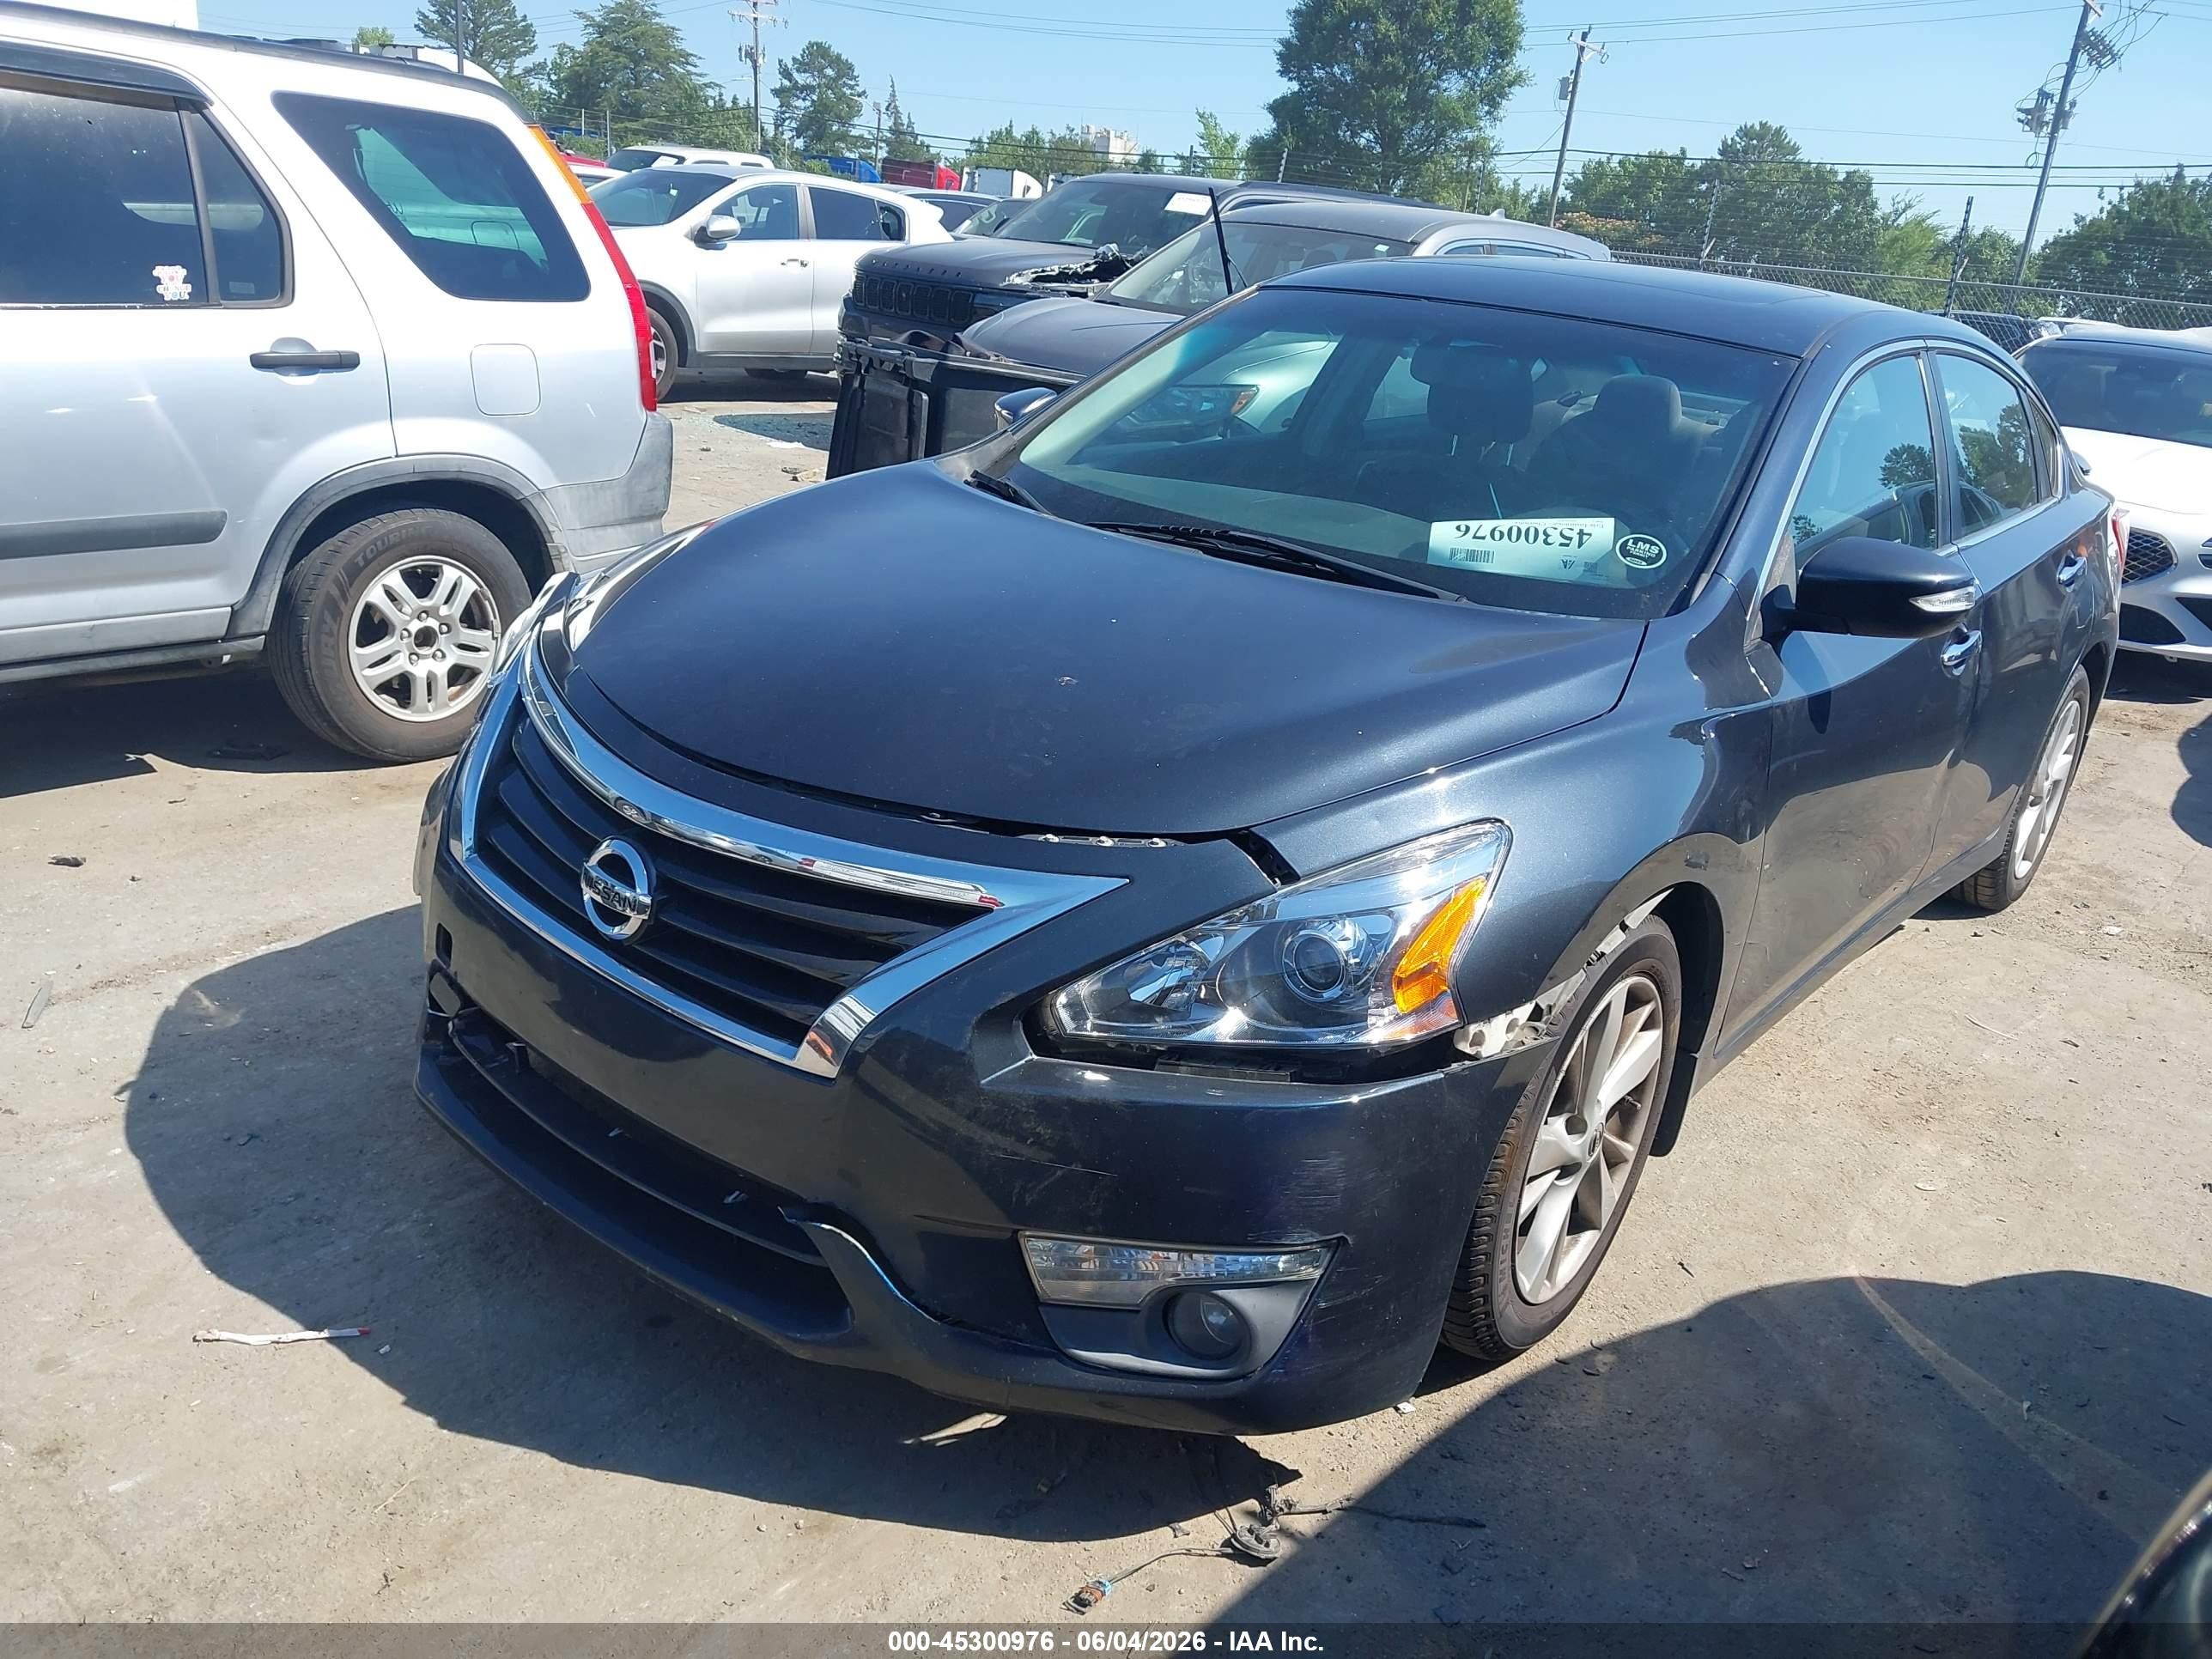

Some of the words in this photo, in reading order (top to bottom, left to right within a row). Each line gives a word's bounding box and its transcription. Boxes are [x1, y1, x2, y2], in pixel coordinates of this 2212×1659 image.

[1455, 524, 1593, 550] 45300976
[1627, 538, 1660, 554] LMS
[1626, 545, 1656, 558] PARKING
[582, 871, 638, 913] NISSAN
